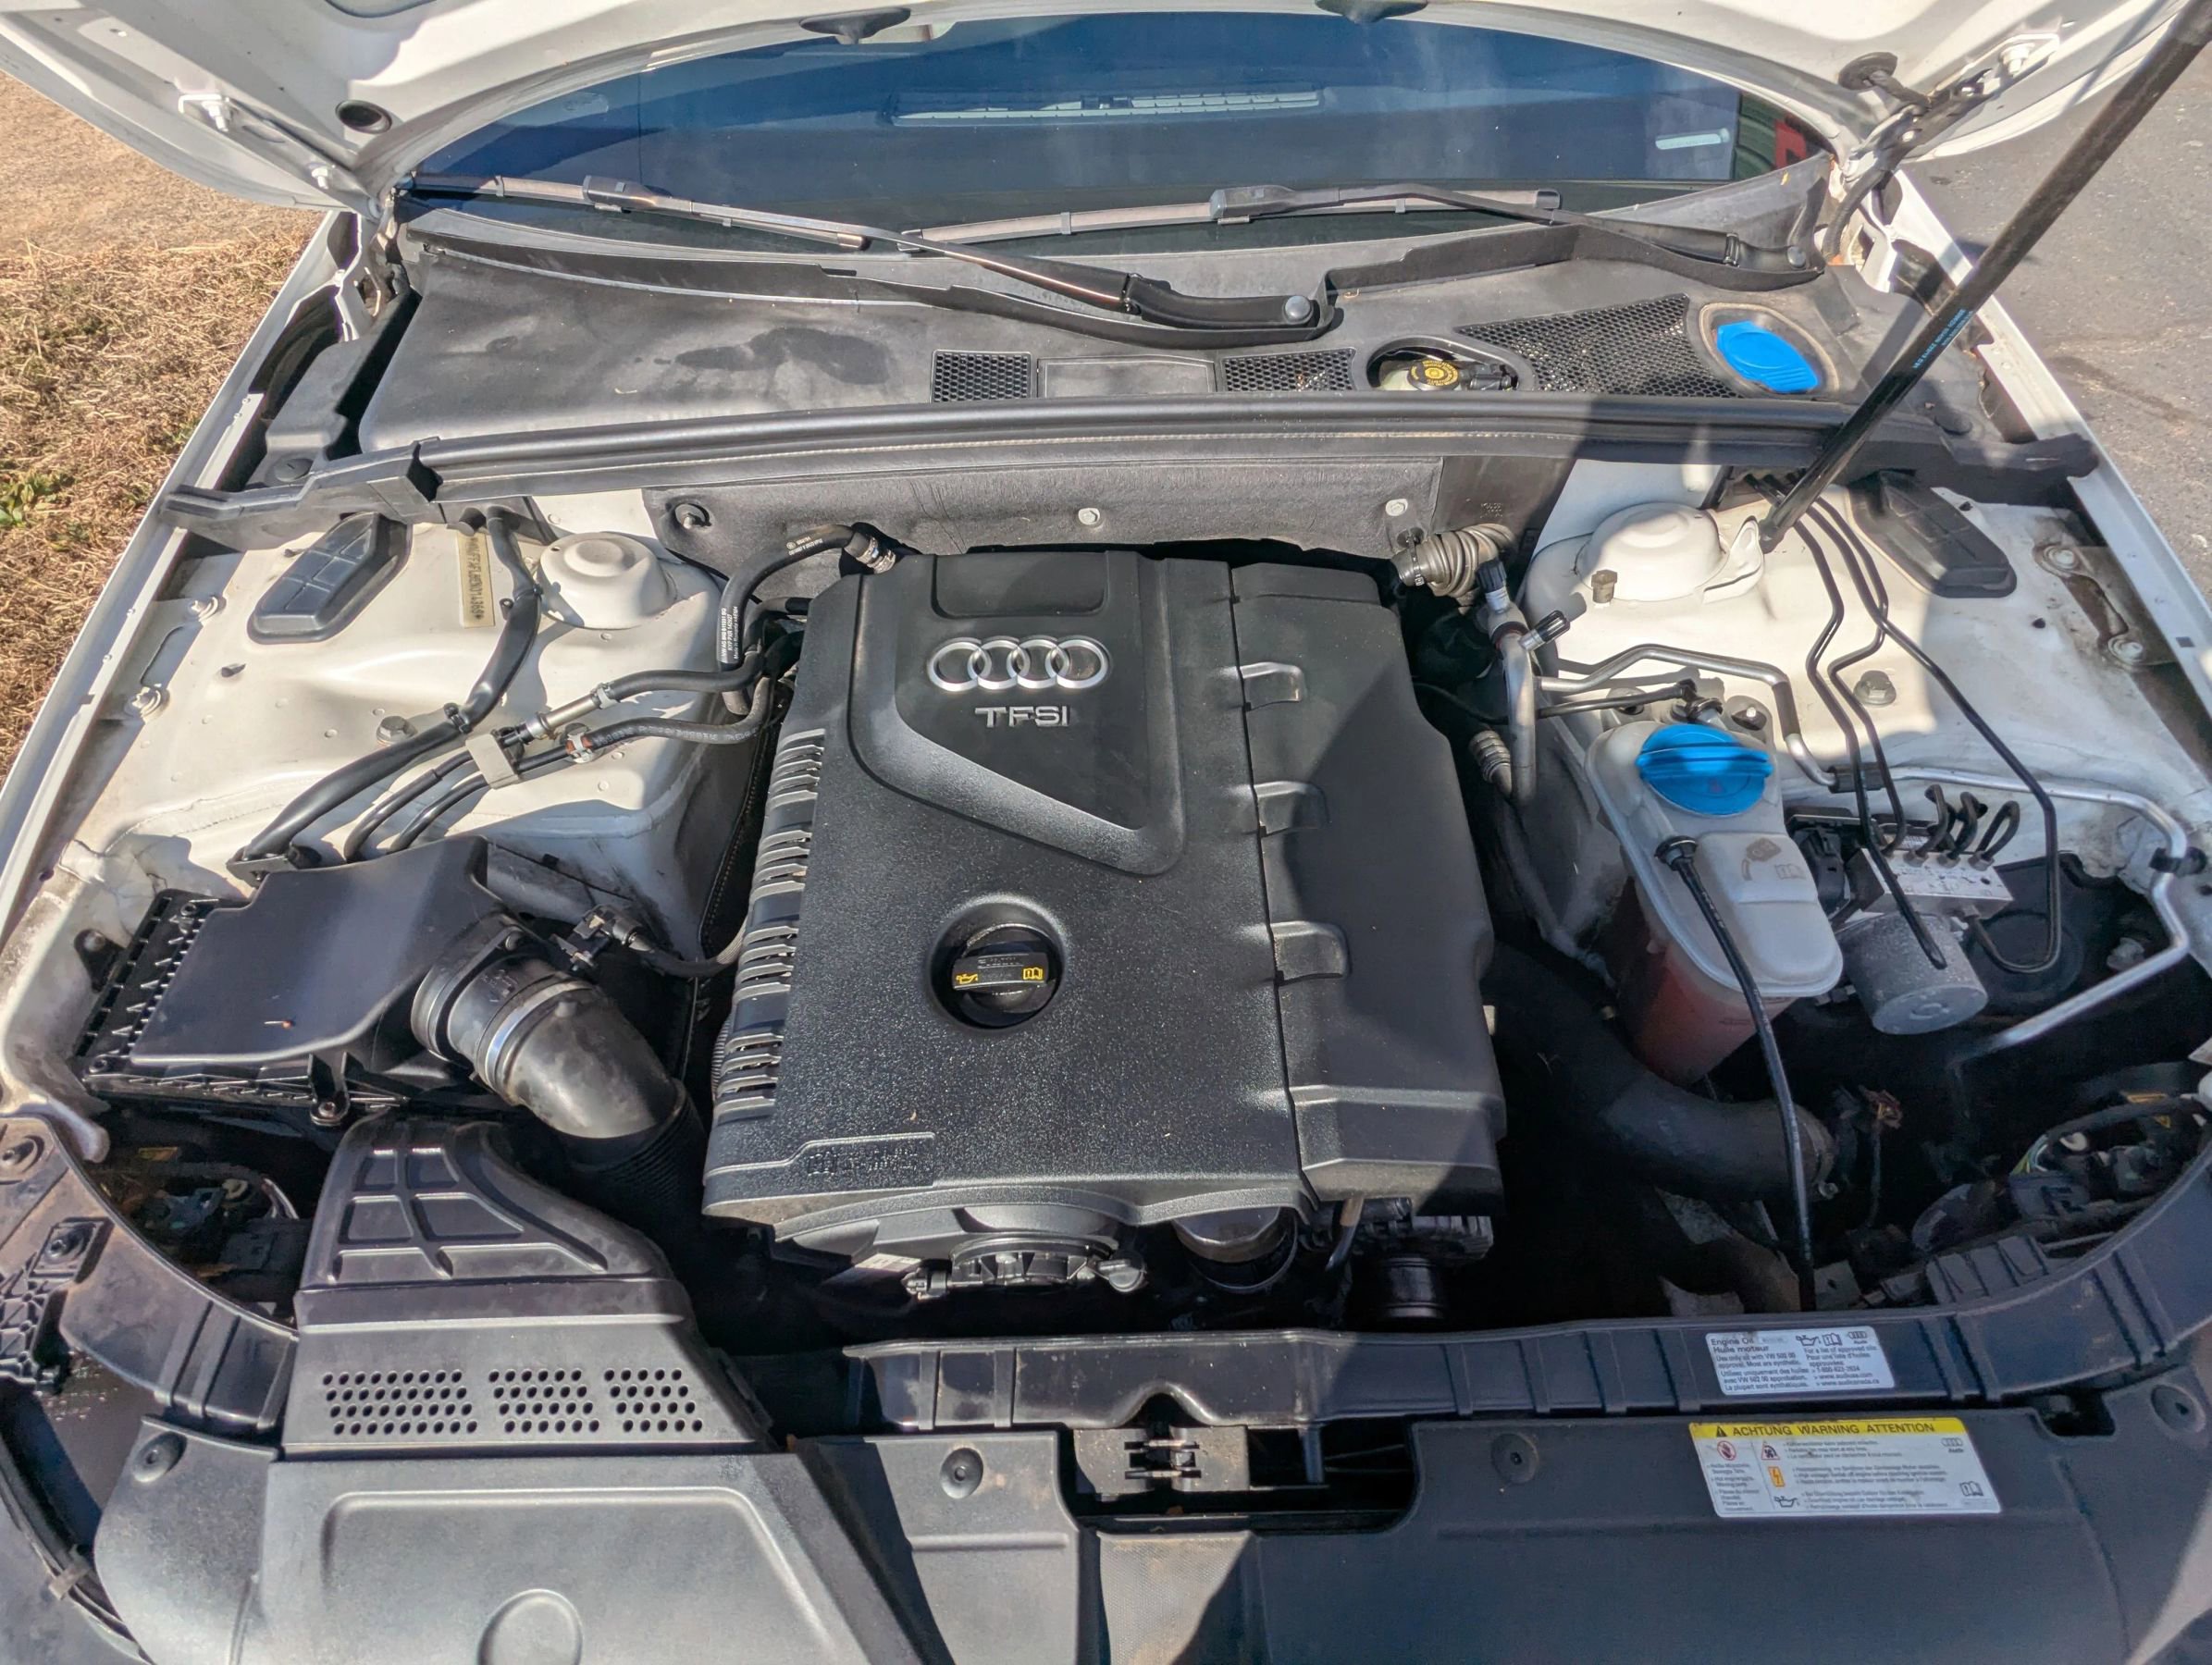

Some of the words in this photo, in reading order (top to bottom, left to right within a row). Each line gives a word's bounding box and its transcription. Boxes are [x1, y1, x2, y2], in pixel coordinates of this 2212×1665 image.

[974, 705, 1071, 728] TFSI
[1711, 1338, 1740, 1347] Engine
[1732, 1424, 1792, 1437] ACHTUNG
[1798, 1424, 1860, 1436] WARNING
[1866, 1422, 1935, 1434] ATTENTION
